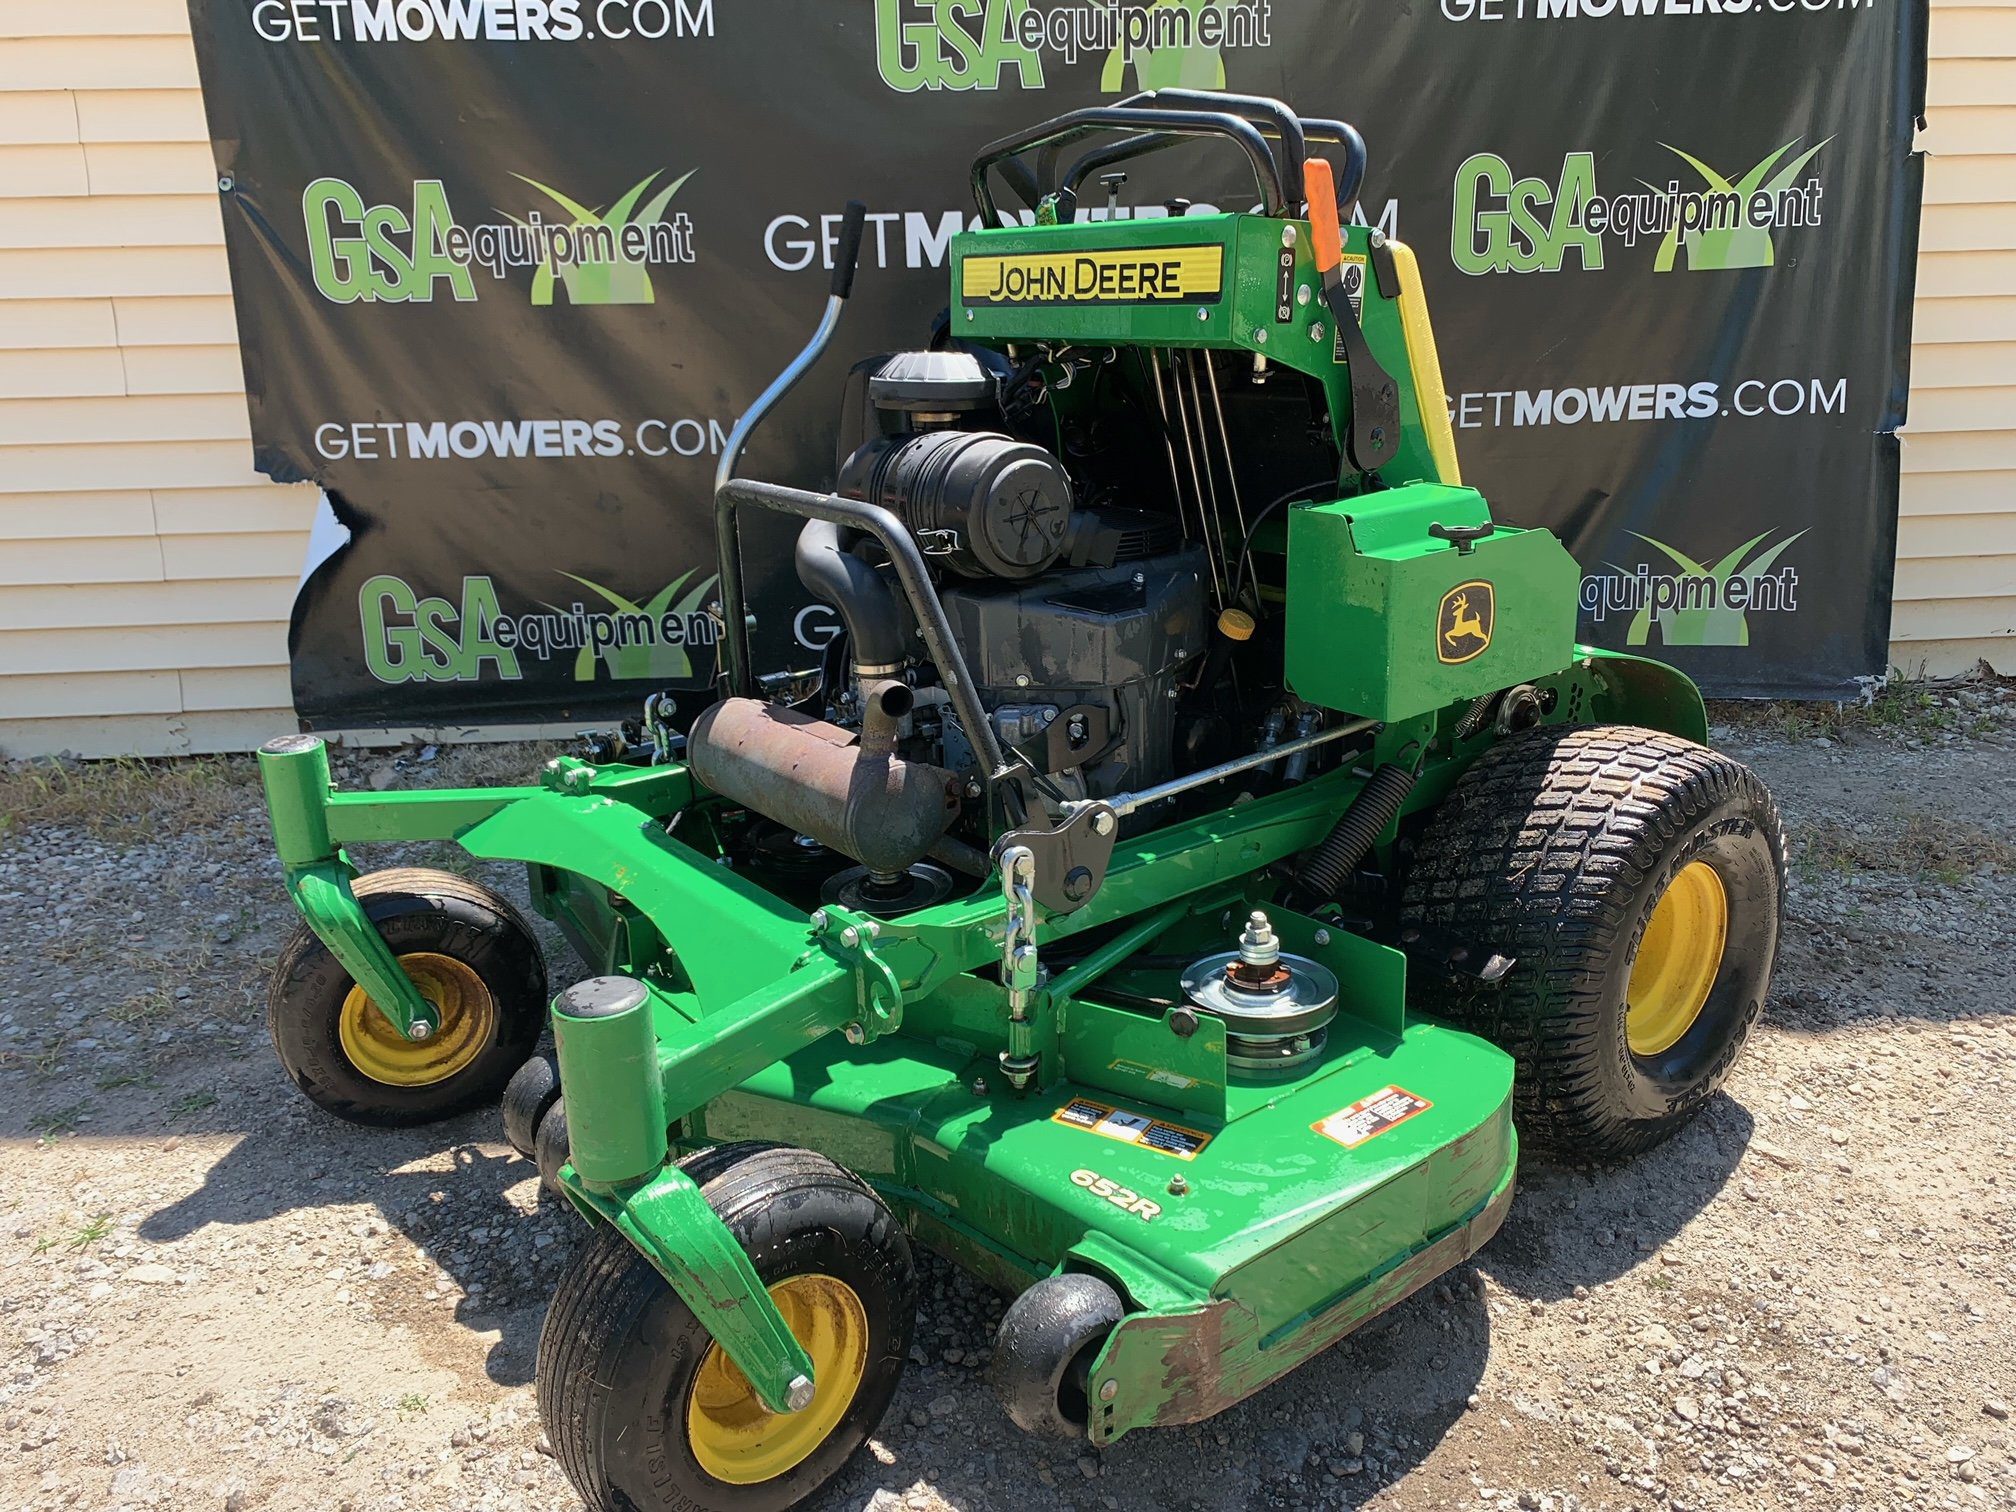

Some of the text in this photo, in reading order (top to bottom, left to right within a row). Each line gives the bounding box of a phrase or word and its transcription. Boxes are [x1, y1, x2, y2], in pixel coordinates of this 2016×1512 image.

[252, 0, 715, 42] GETMOWERS.COM
[1017, 0, 1271, 64] equipment
[1581, 178, 1824, 248] equipment
[444, 211, 697, 279] equipment
[989, 258, 1182, 298] JOHN DEERE
[1578, 563, 1798, 622] quipment
[492, 602, 719, 661] equipmen
[1068, 1168, 1163, 1224] 652R
